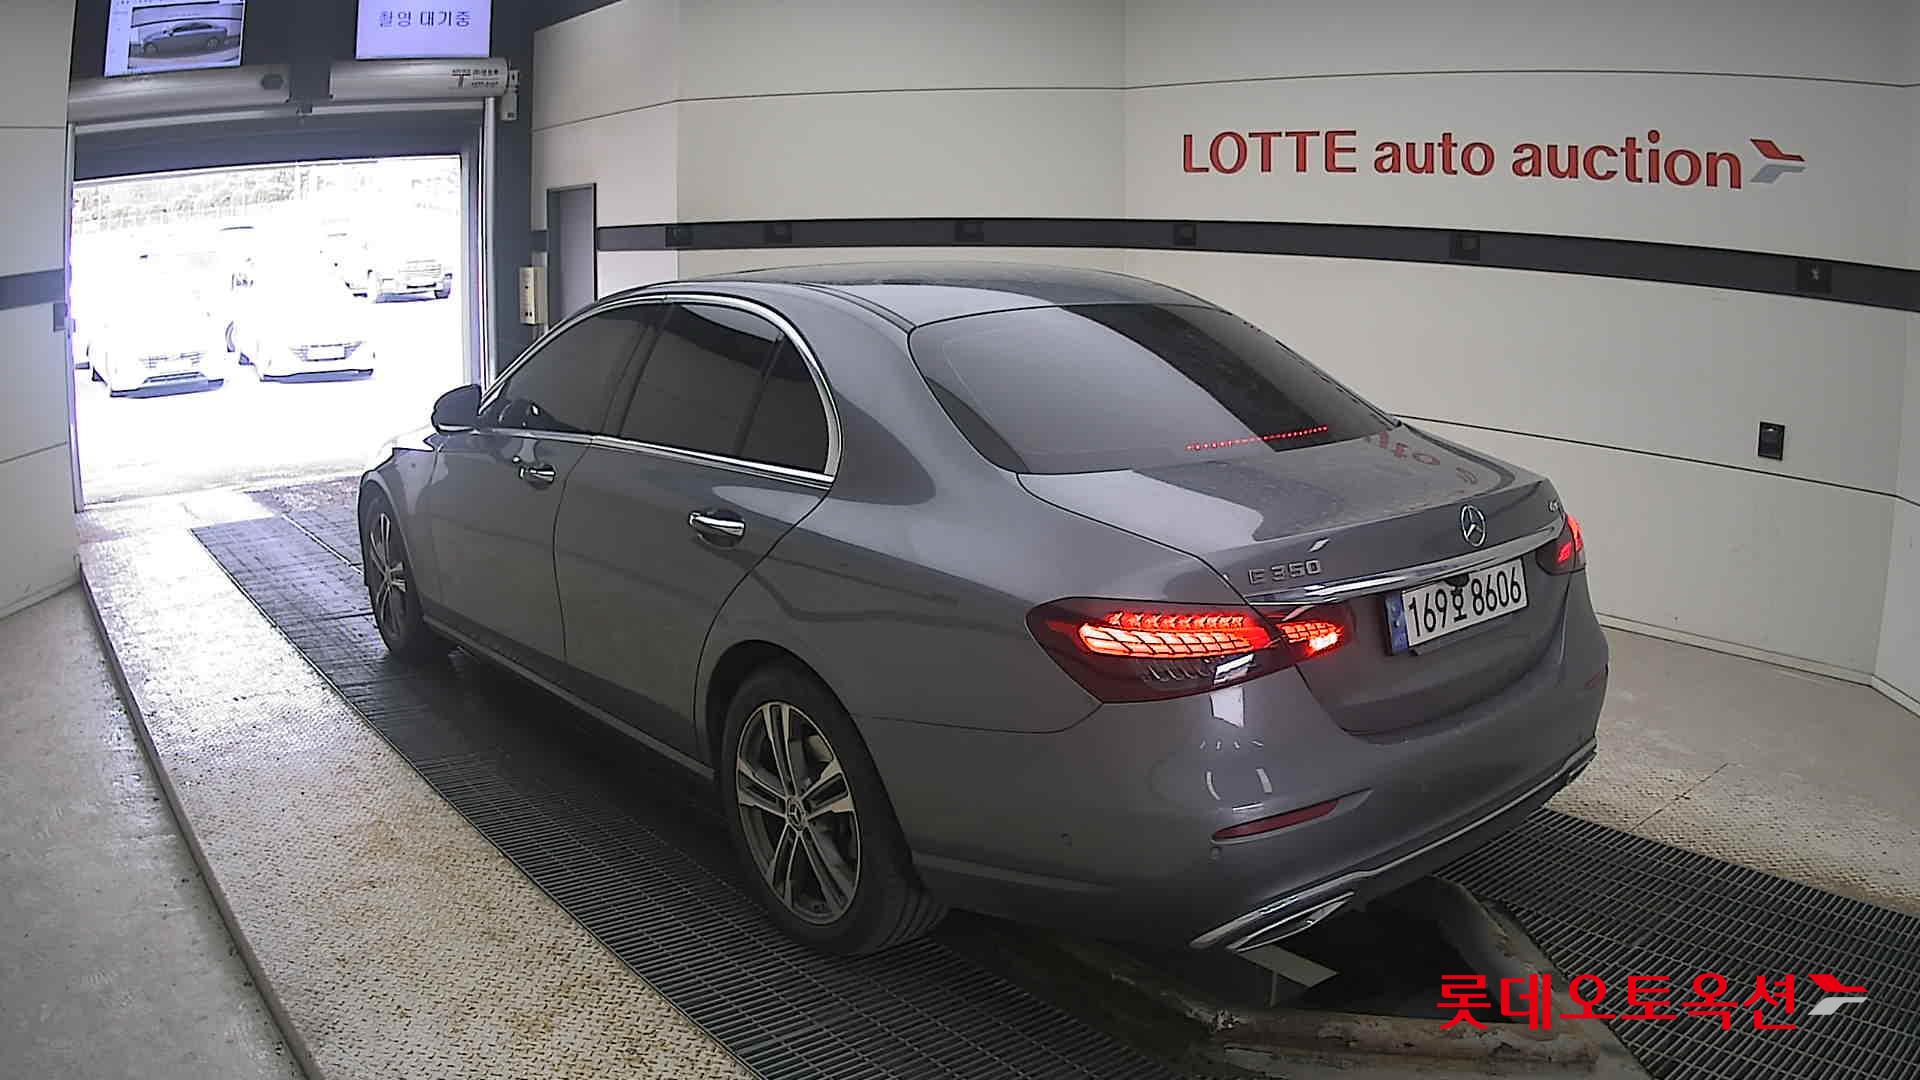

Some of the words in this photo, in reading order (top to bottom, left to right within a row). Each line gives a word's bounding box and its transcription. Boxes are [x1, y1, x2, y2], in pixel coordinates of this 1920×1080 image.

[420, 10, 471, 28] 대기중
[1183, 130, 1358, 174] LOTTE
[1374, 132, 1495, 176] auto
[1512, 129, 1742, 189] auction
[1248, 568, 1265, 585] E
[1271, 559, 1321, 582] 350
